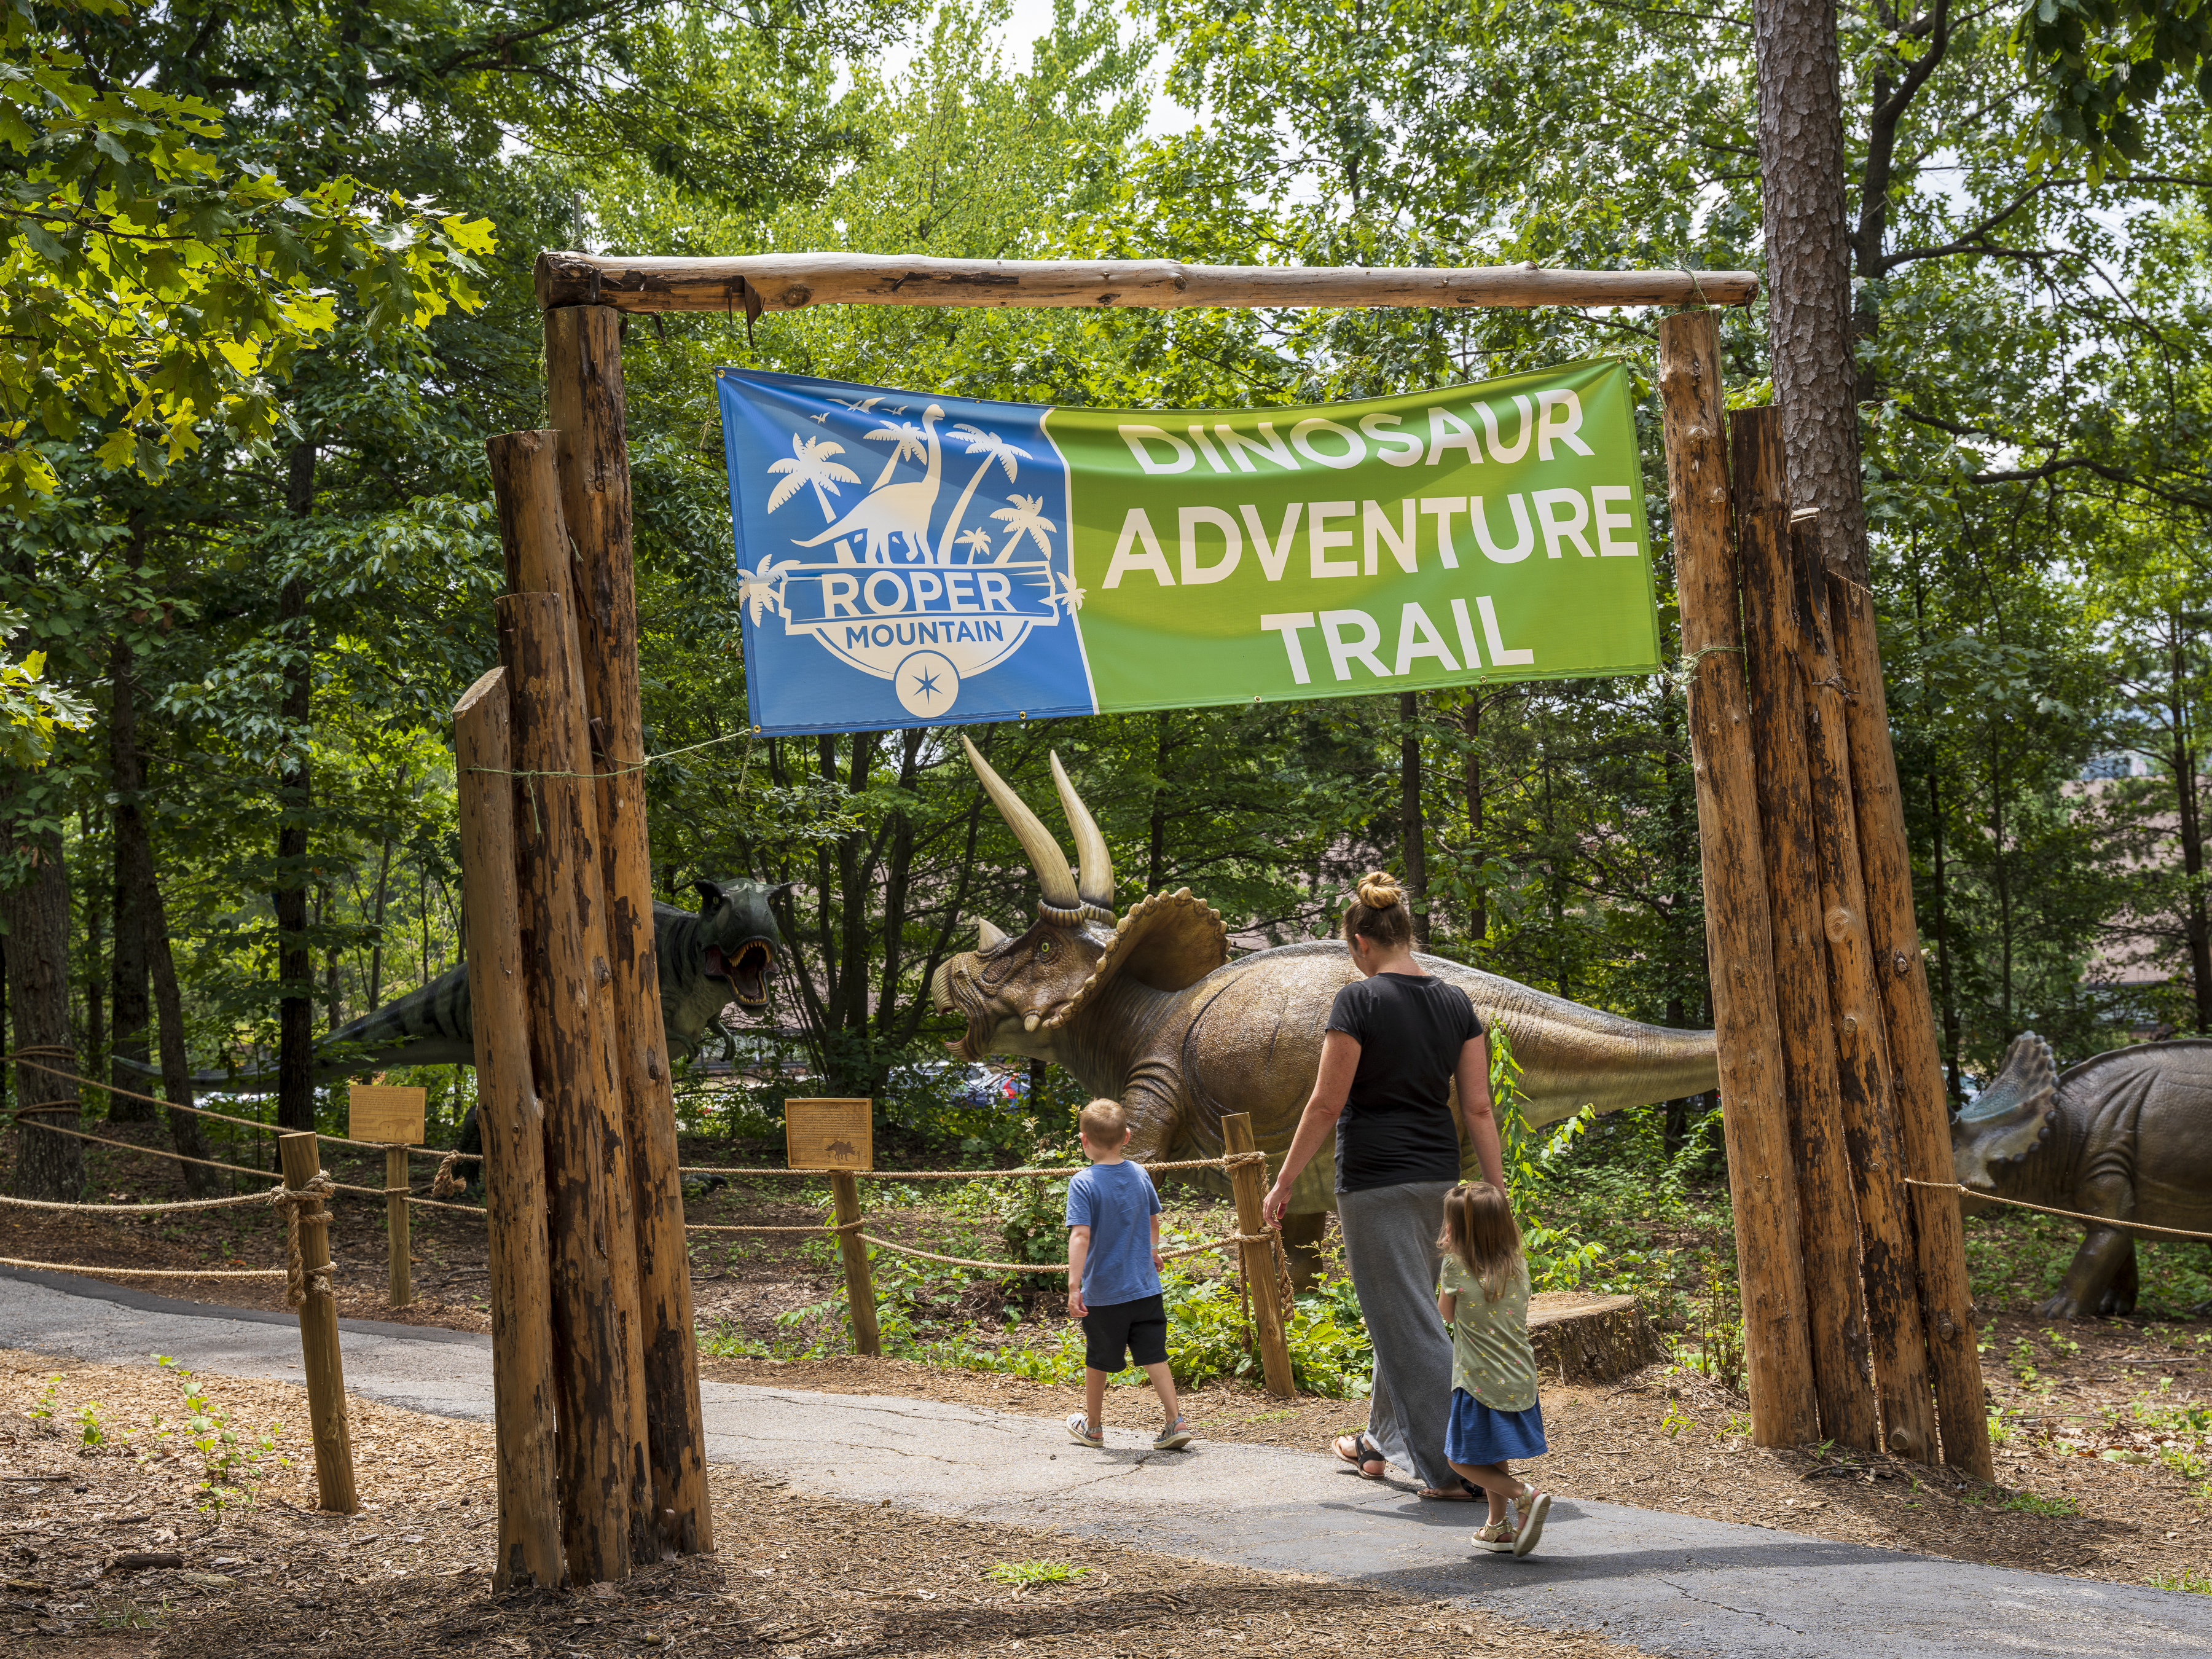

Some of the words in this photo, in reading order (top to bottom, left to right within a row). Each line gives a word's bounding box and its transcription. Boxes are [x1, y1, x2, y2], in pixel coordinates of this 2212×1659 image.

[1118, 388, 1595, 474] DINOSAUR
[1102, 485, 1639, 589] ADVENTURE
[822, 570, 1018, 618] ROPER
[845, 621, 1004, 649] MOUNTAIN
[1260, 595, 1534, 684] TRAIL
